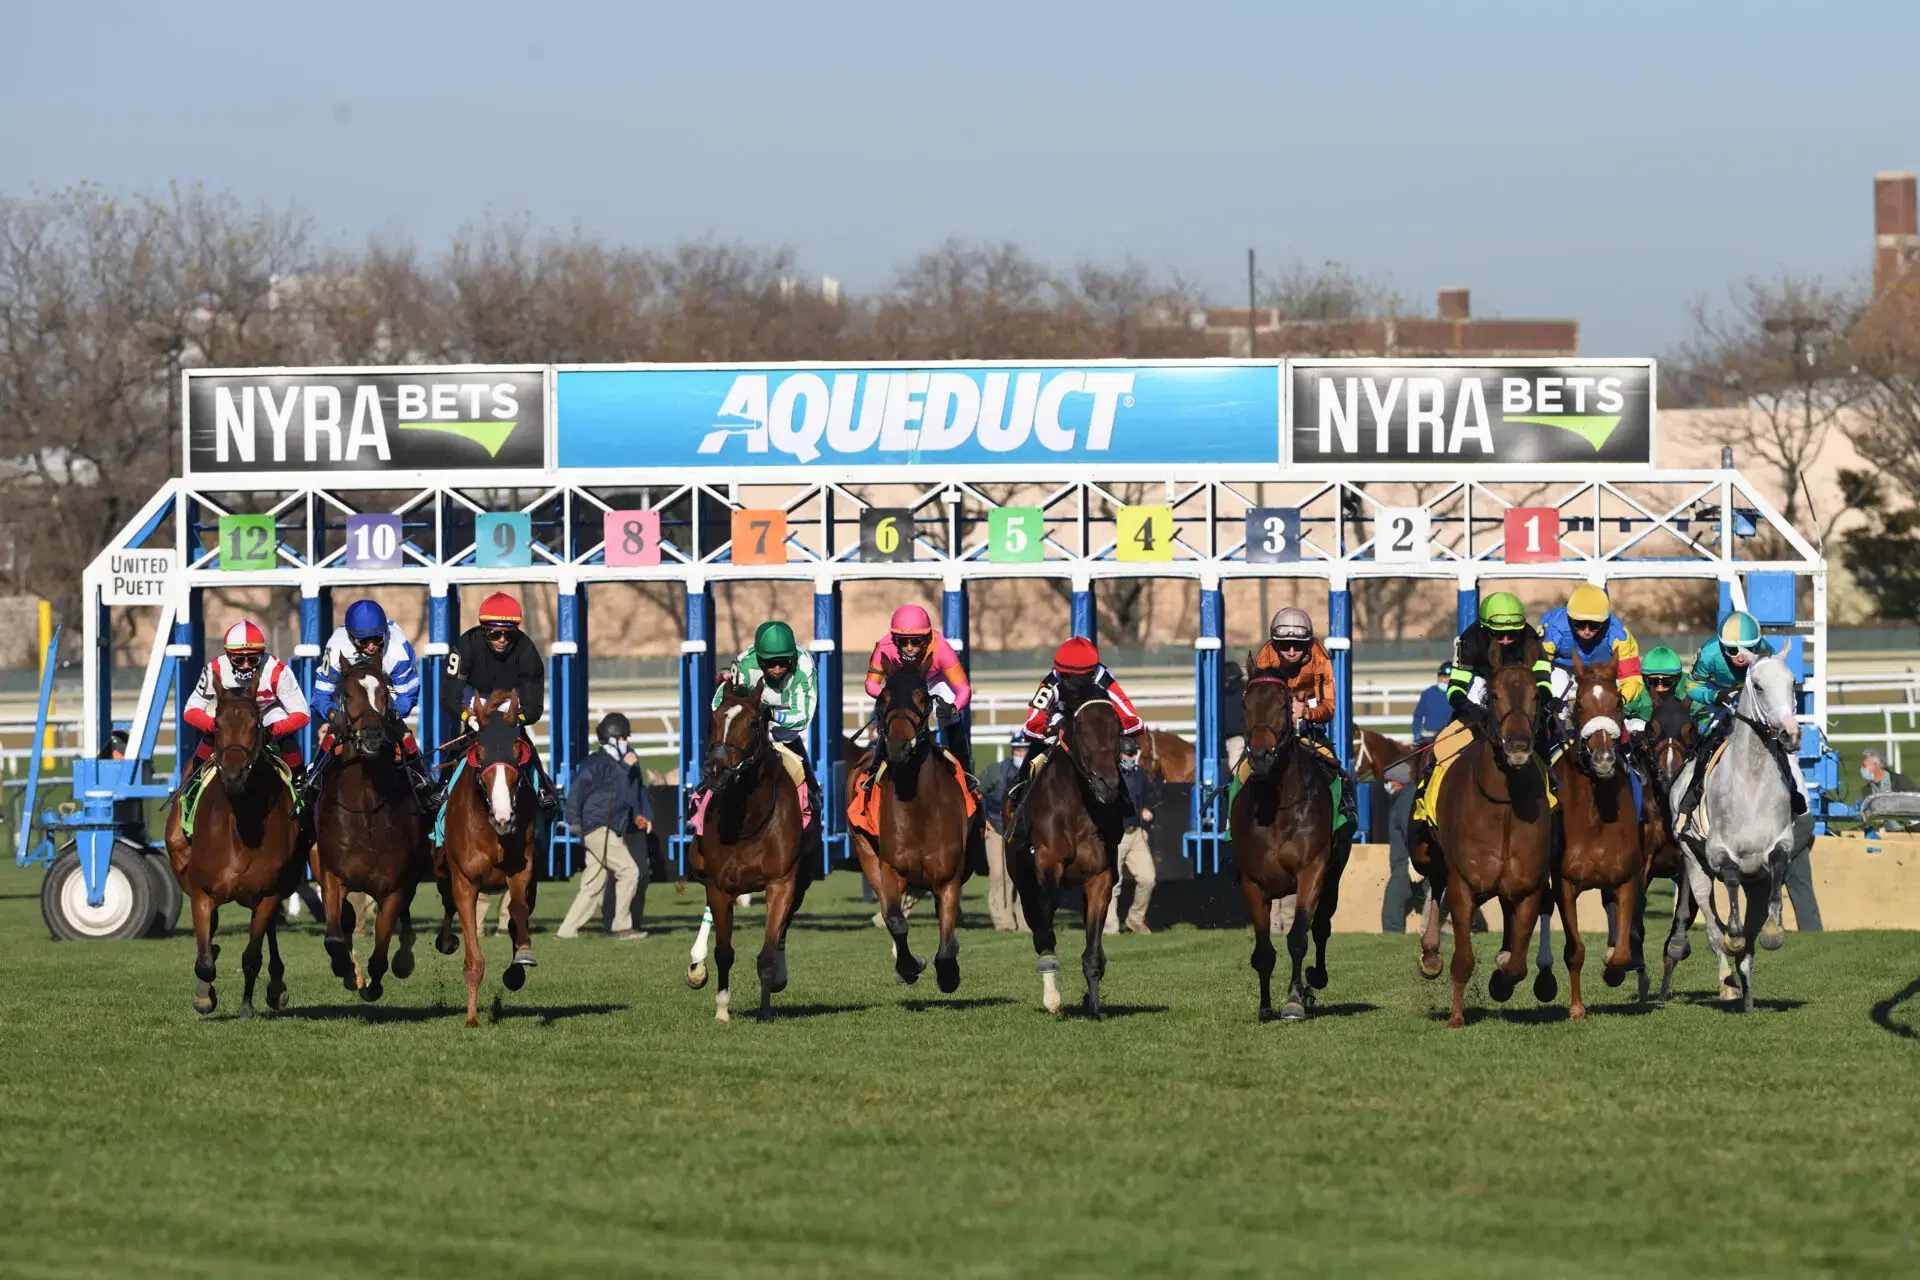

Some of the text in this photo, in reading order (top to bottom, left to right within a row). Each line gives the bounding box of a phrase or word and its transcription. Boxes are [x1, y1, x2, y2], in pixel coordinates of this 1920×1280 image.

[215, 383, 519, 462] NYRA BETS
[697, 372, 1135, 464] AQUEDUCT
[1318, 377, 1624, 453] NYRA BETS
[227, 525, 268, 561] 12
[354, 524, 396, 560] 10
[493, 522, 516, 558] 9
[622, 520, 644, 555] 8
[750, 520, 772, 555] 7
[875, 516, 899, 554] 6
[1005, 516, 1028, 553] 5
[1133, 516, 1156, 551] 4
[1263, 517, 1286, 554] 3
[1391, 517, 1414, 552] 2
[1523, 515, 1541, 552] 1
[111, 555, 168, 574] UNITED
[114, 576, 164, 595] PUETT
[447, 652, 460, 675] 9
